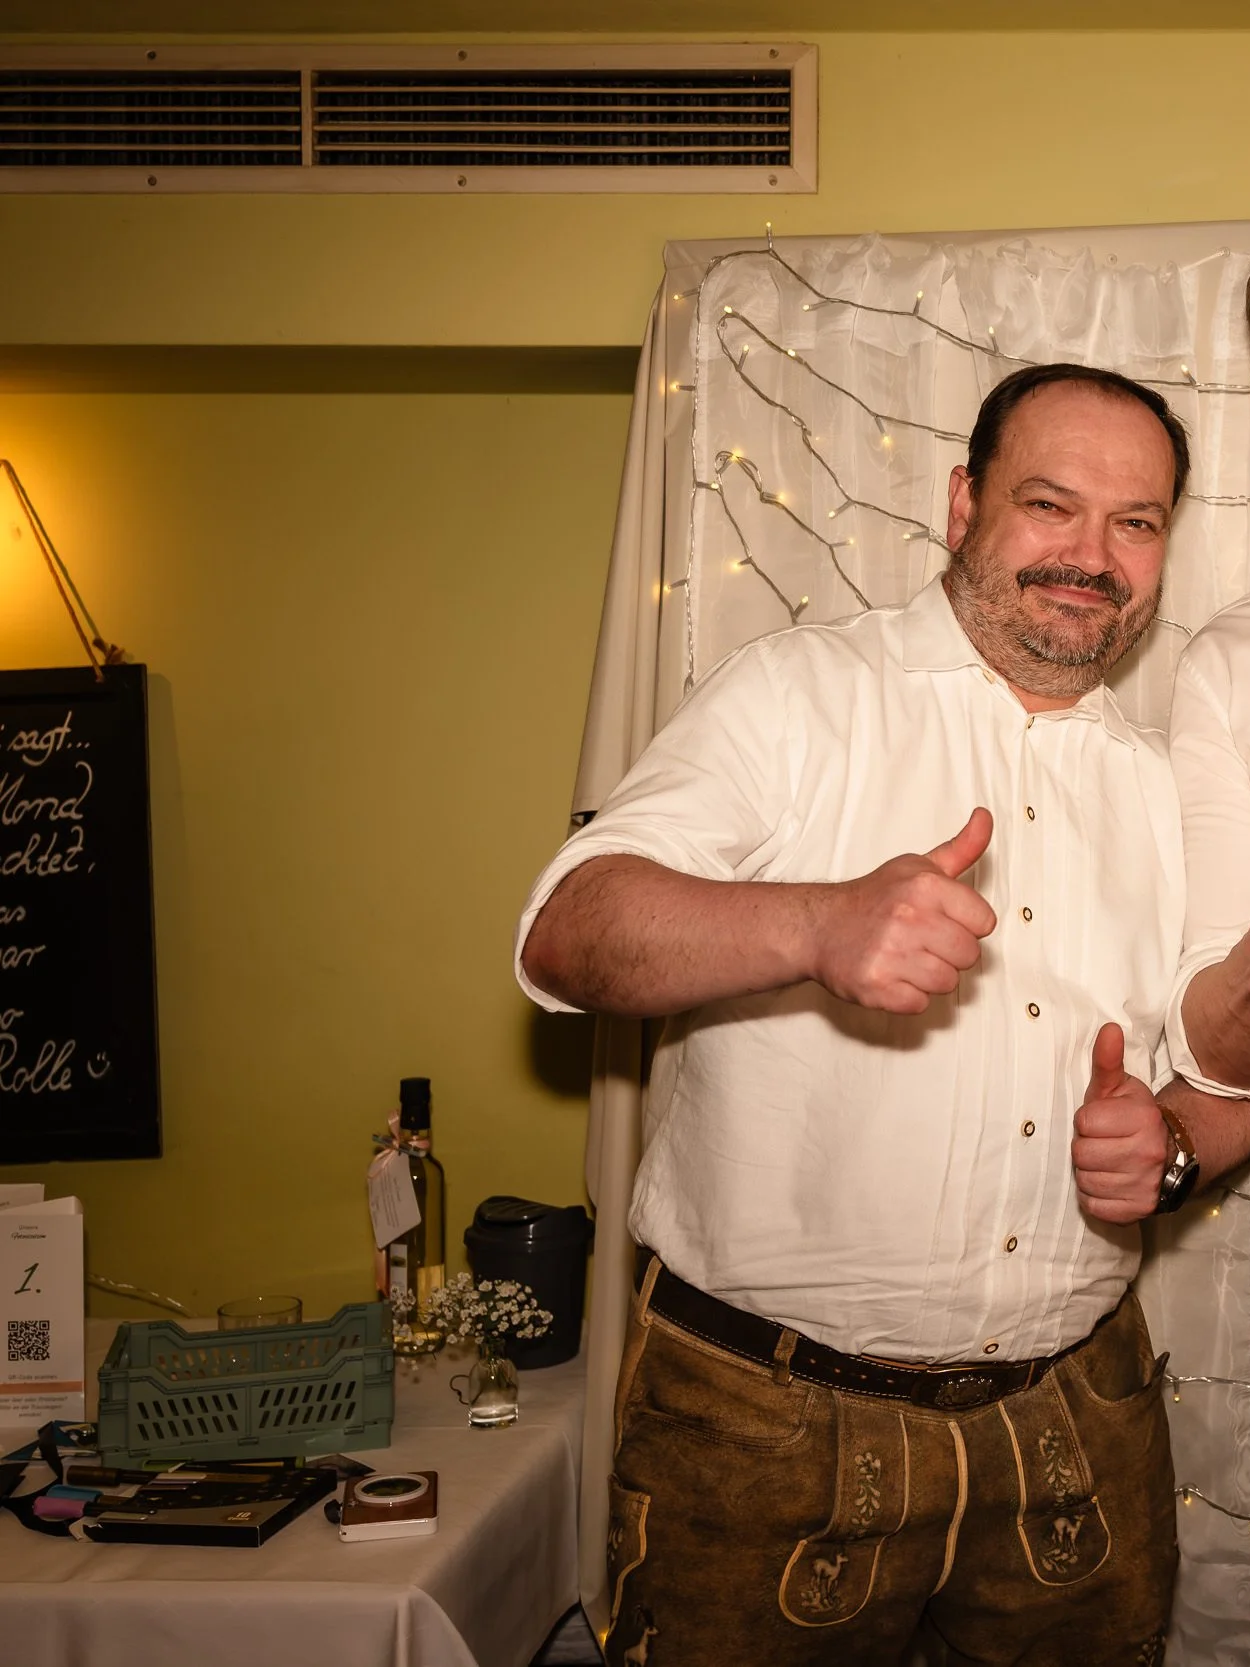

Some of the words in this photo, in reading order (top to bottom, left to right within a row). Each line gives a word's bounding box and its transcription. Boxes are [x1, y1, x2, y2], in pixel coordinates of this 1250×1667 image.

[0, 825, 95, 877] chtet,
[0, 905, 26, 924] as
[0, 944, 47, 969] ar
[14, 1262, 41, 1295] 1.
